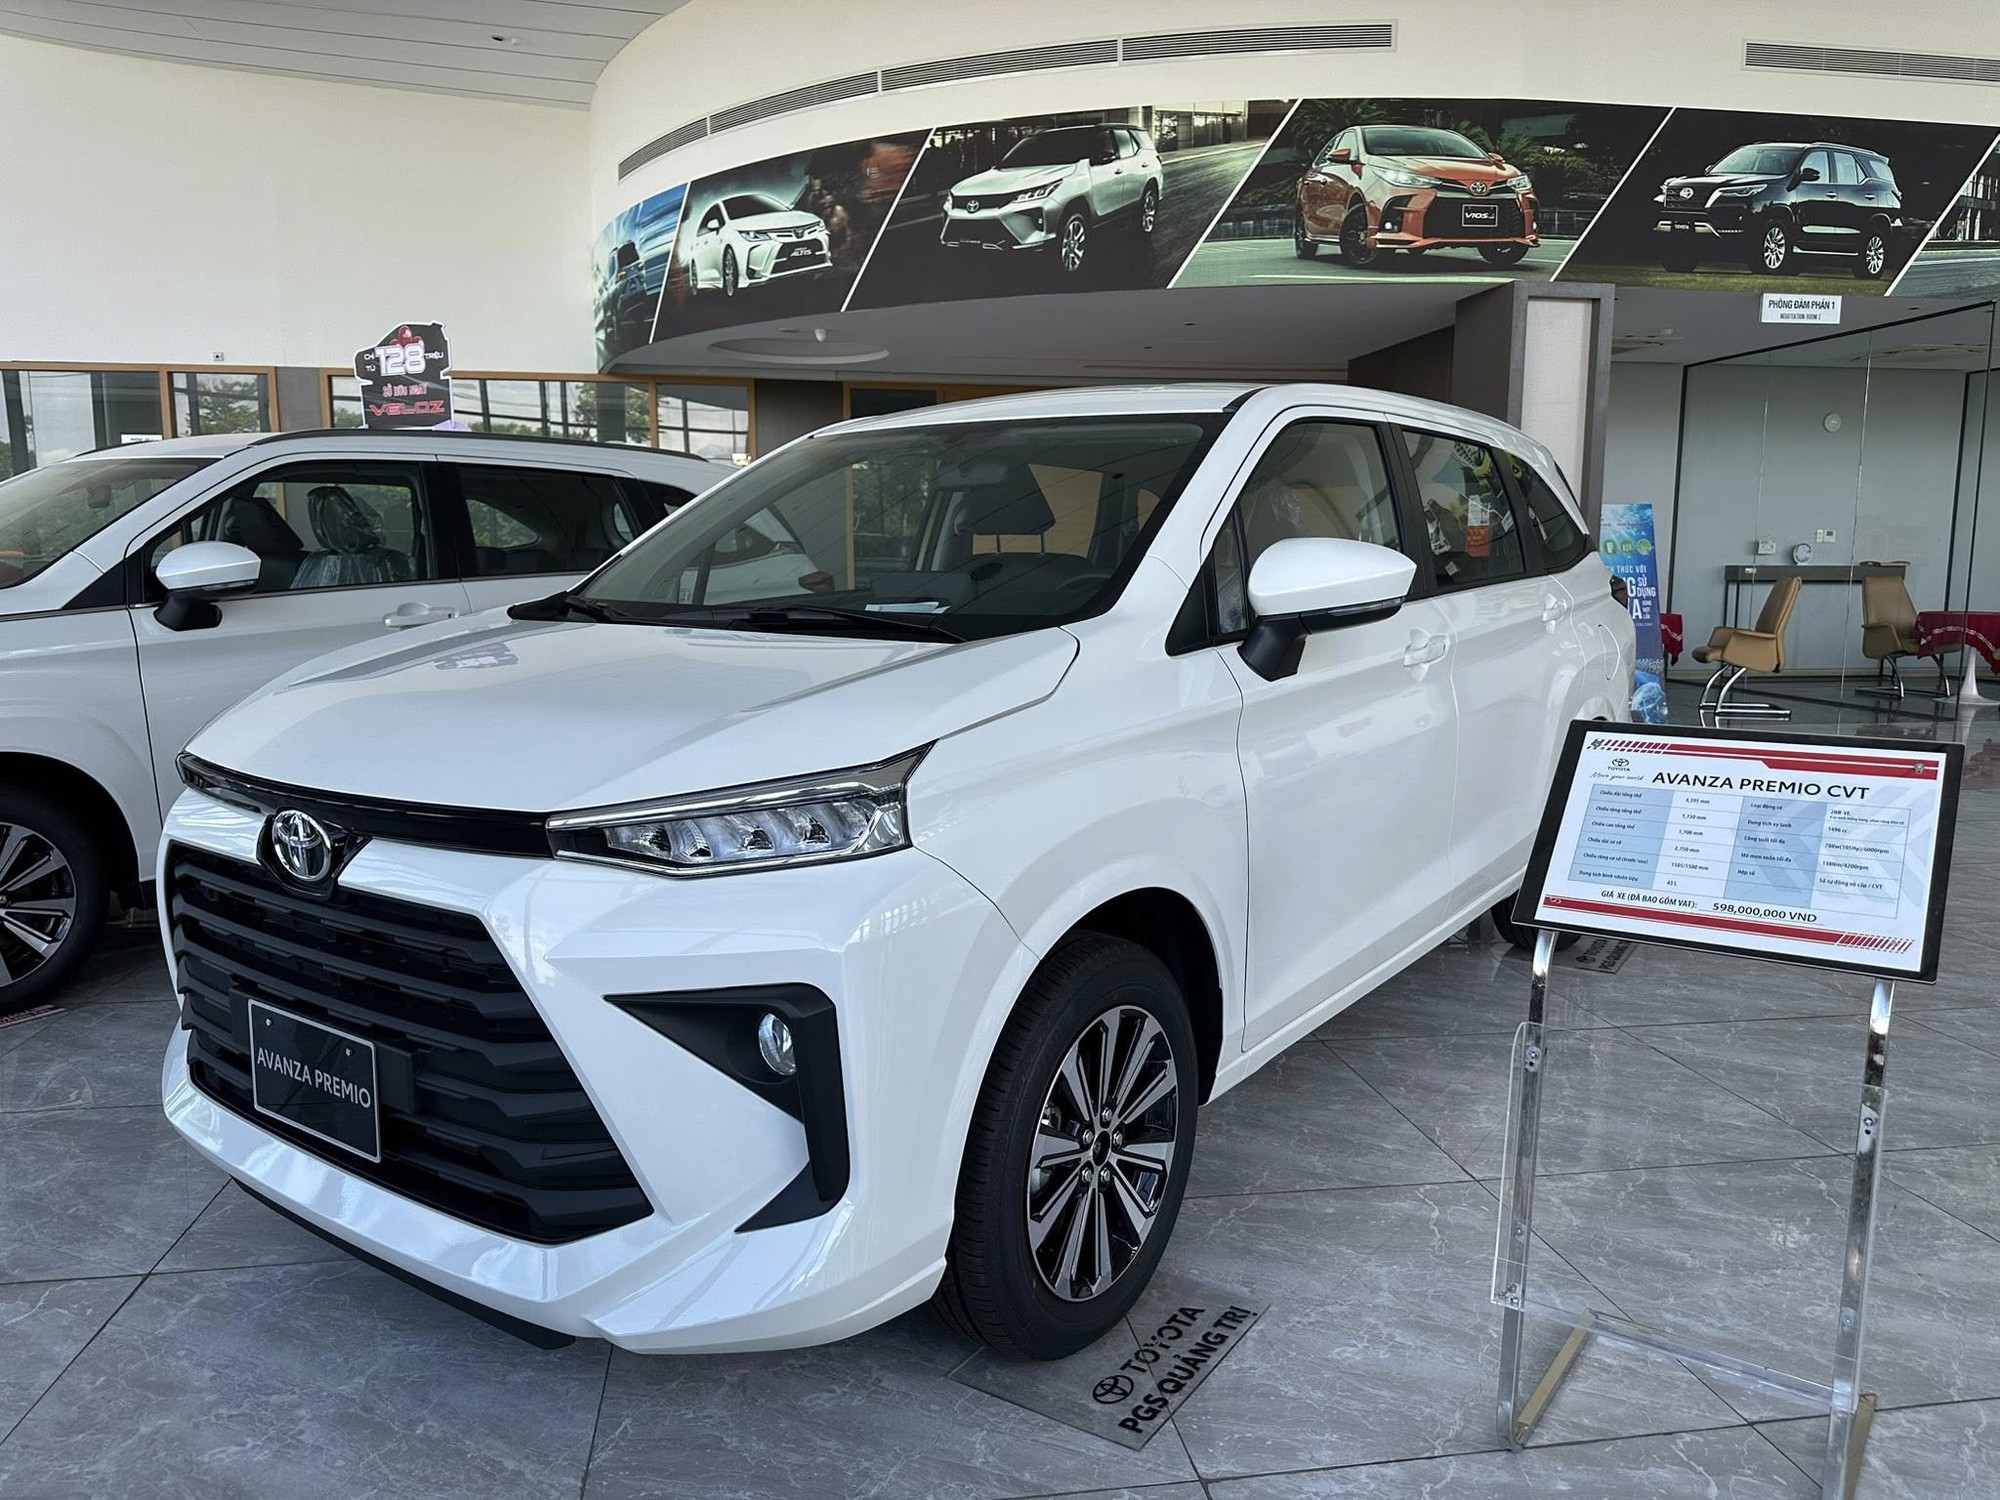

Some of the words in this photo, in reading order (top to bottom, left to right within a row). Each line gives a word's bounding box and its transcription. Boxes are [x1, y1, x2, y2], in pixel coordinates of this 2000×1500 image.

[1768, 297, 1793, 309] PHÒNG
[1794, 298, 1810, 309] ĐÀM
[1832, 301, 1835, 309] 1
[375, 342, 426, 376] 128
[369, 400, 445, 416] VELOZ
[1652, 772, 1734, 789] AVANZA
[1739, 779, 1821, 796] PREMIO
[1827, 785, 1870, 800] CVT
[1601, 890, 1614, 898] GIÁ
[1616, 891, 1626, 900] XE
[1642, 894, 1658, 904] BAO
[1712, 902, 1786, 919] 598,000,000
[1789, 911, 1817, 923] VND
[257, 1047, 312, 1086] AVANZA
[314, 1068, 371, 1109] PREMIO
[1119, 1306, 1206, 1374] TOYOTA
[1118, 1394, 1170, 1434] PGS
[1157, 1331, 1230, 1395] QUẢNG
[1212, 1305, 1259, 1332] TRỊ
